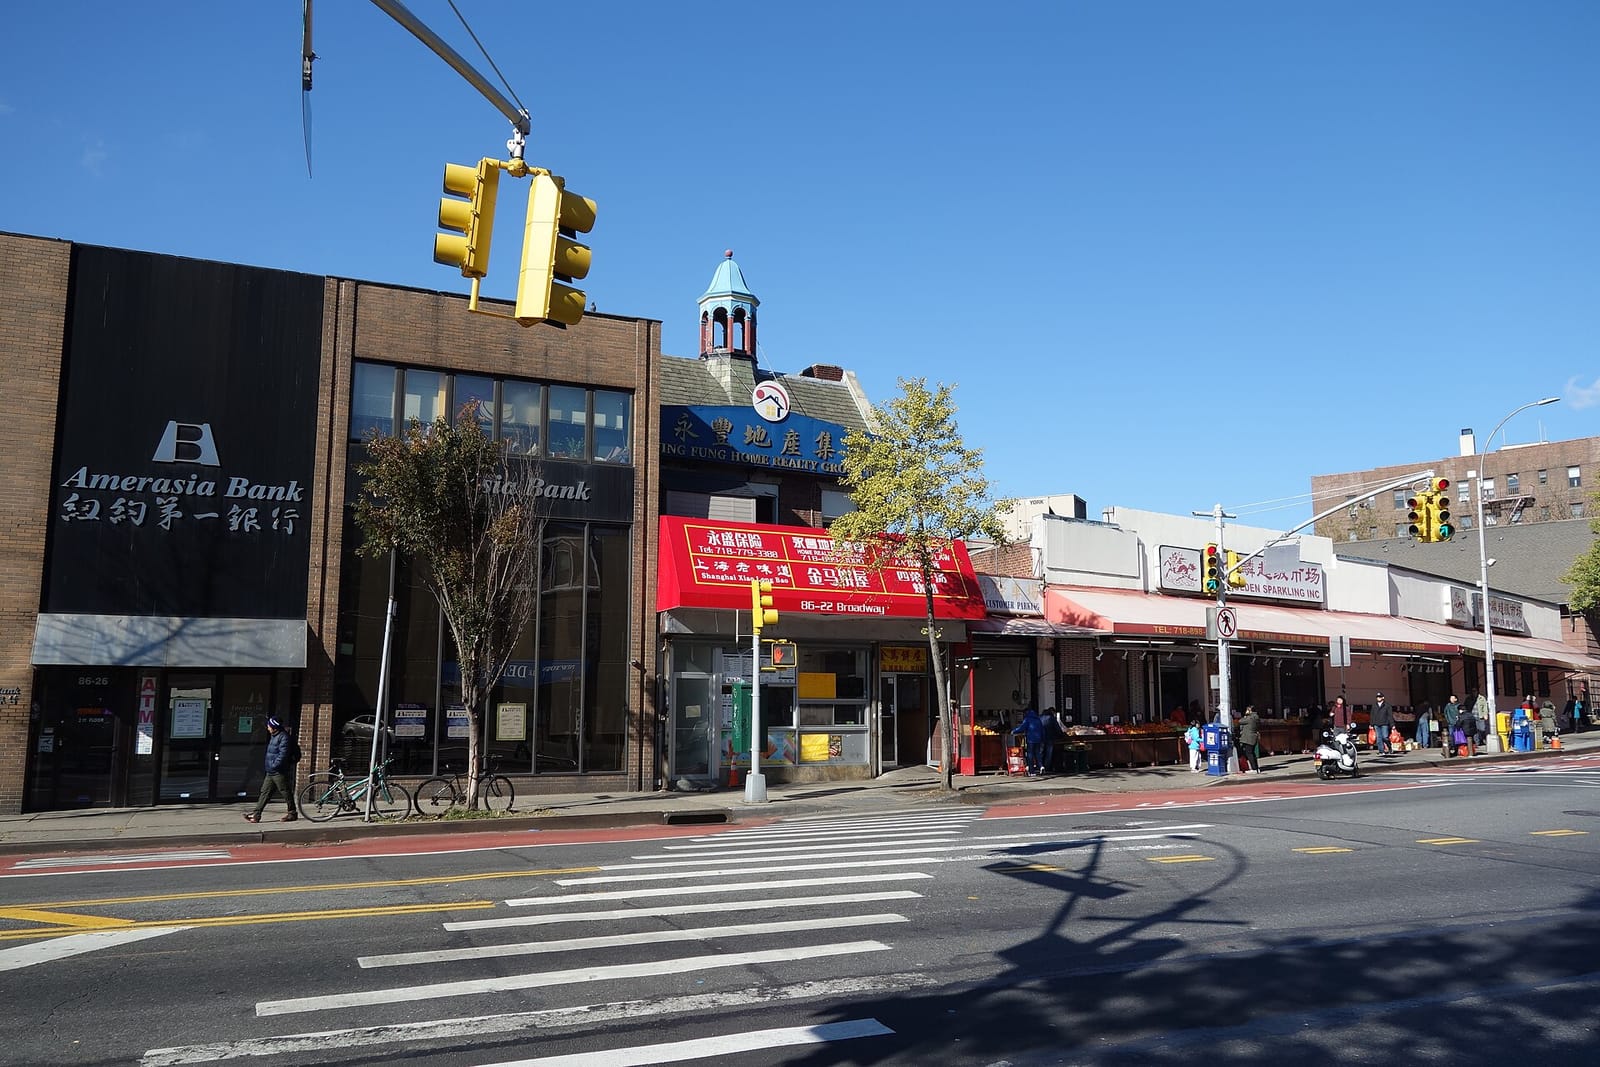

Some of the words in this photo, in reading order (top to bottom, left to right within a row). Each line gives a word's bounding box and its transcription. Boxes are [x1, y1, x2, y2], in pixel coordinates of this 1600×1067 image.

[674, 413, 838, 461] 永豐地產集
[660, 442, 686, 456] ING
[691, 446, 727, 460] FUNG
[731, 450, 769, 465] HOME
[772, 455, 819, 470] REALTY
[61, 466, 216, 497] Amerasia
[224, 476, 305, 502] Bank
[526, 478, 591, 501] Bank
[701, 572, 737, 581] Shanghai
[1262, 584, 1305, 597] SPARKLING
[1306, 590, 1320, 599] INC
[801, 600, 833, 611] 86-22
[836, 602, 885, 615] Broadway
[78, 676, 109, 686] 86-26
[139, 678, 156, 724] ATM
